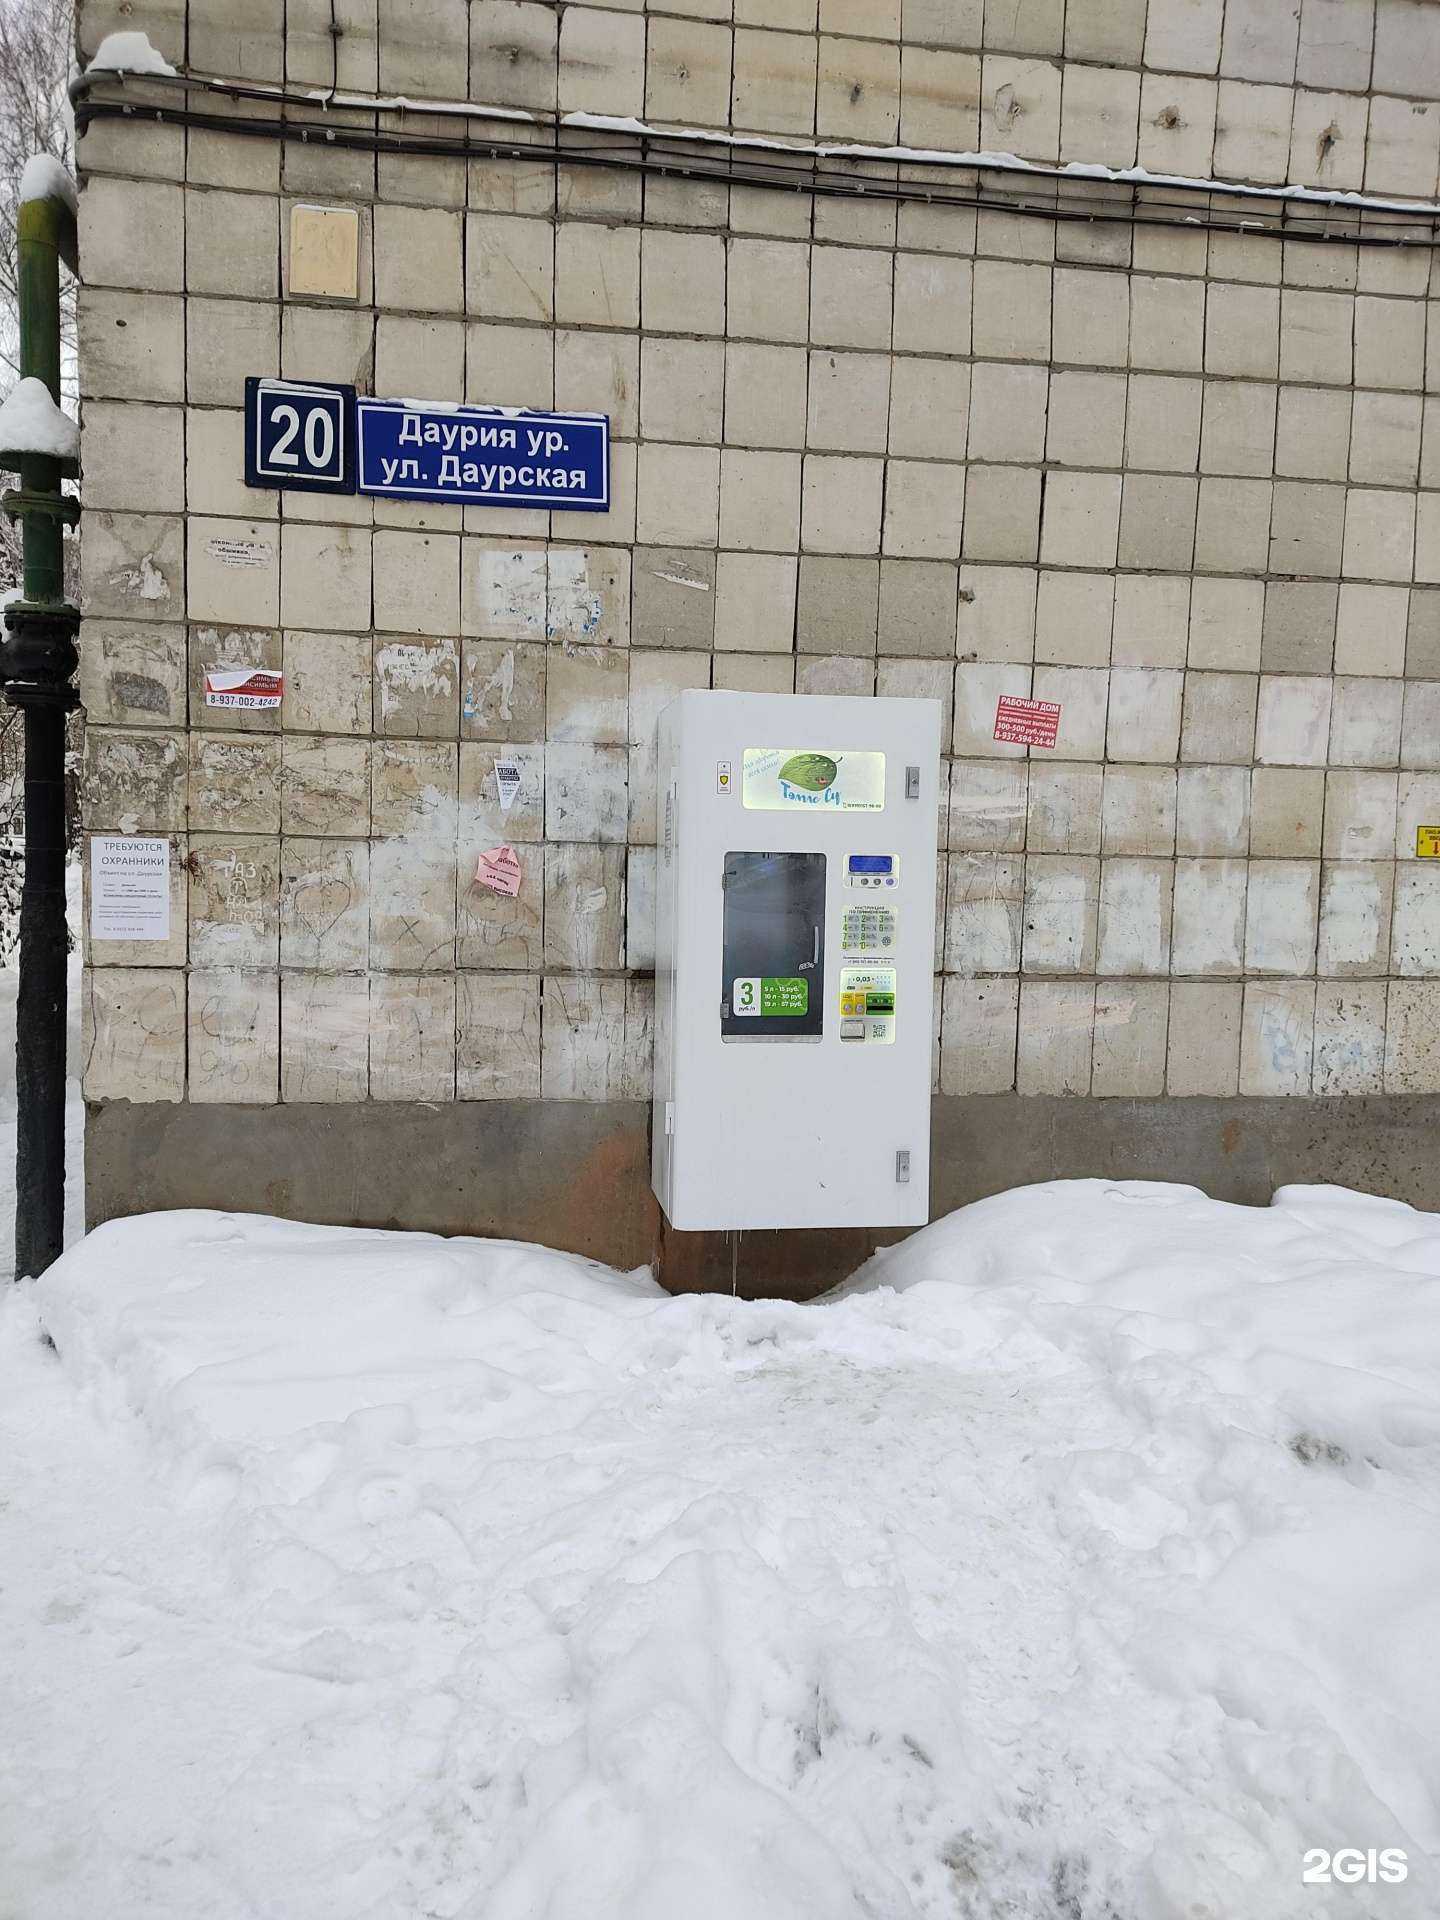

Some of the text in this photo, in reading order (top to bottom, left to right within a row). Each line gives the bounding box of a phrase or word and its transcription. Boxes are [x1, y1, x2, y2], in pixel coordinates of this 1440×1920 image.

[269, 404, 334, 468] 20
[399, 414, 569, 458] Даурия ур.
[381, 456, 587, 491] ул. Даурская
[210, 694, 278, 706] 8-937-002-4242
[1000, 696, 1039, 710] РАБОЧИЙ
[1039, 702, 1059, 713] ДОМ
[997, 721, 1026, 733] 300-500
[104, 842, 162, 852] ТРЕБУЮТСЯ
[101, 856, 164, 866] ОХРАННИКИ
[741, 982, 754, 1005] 3
